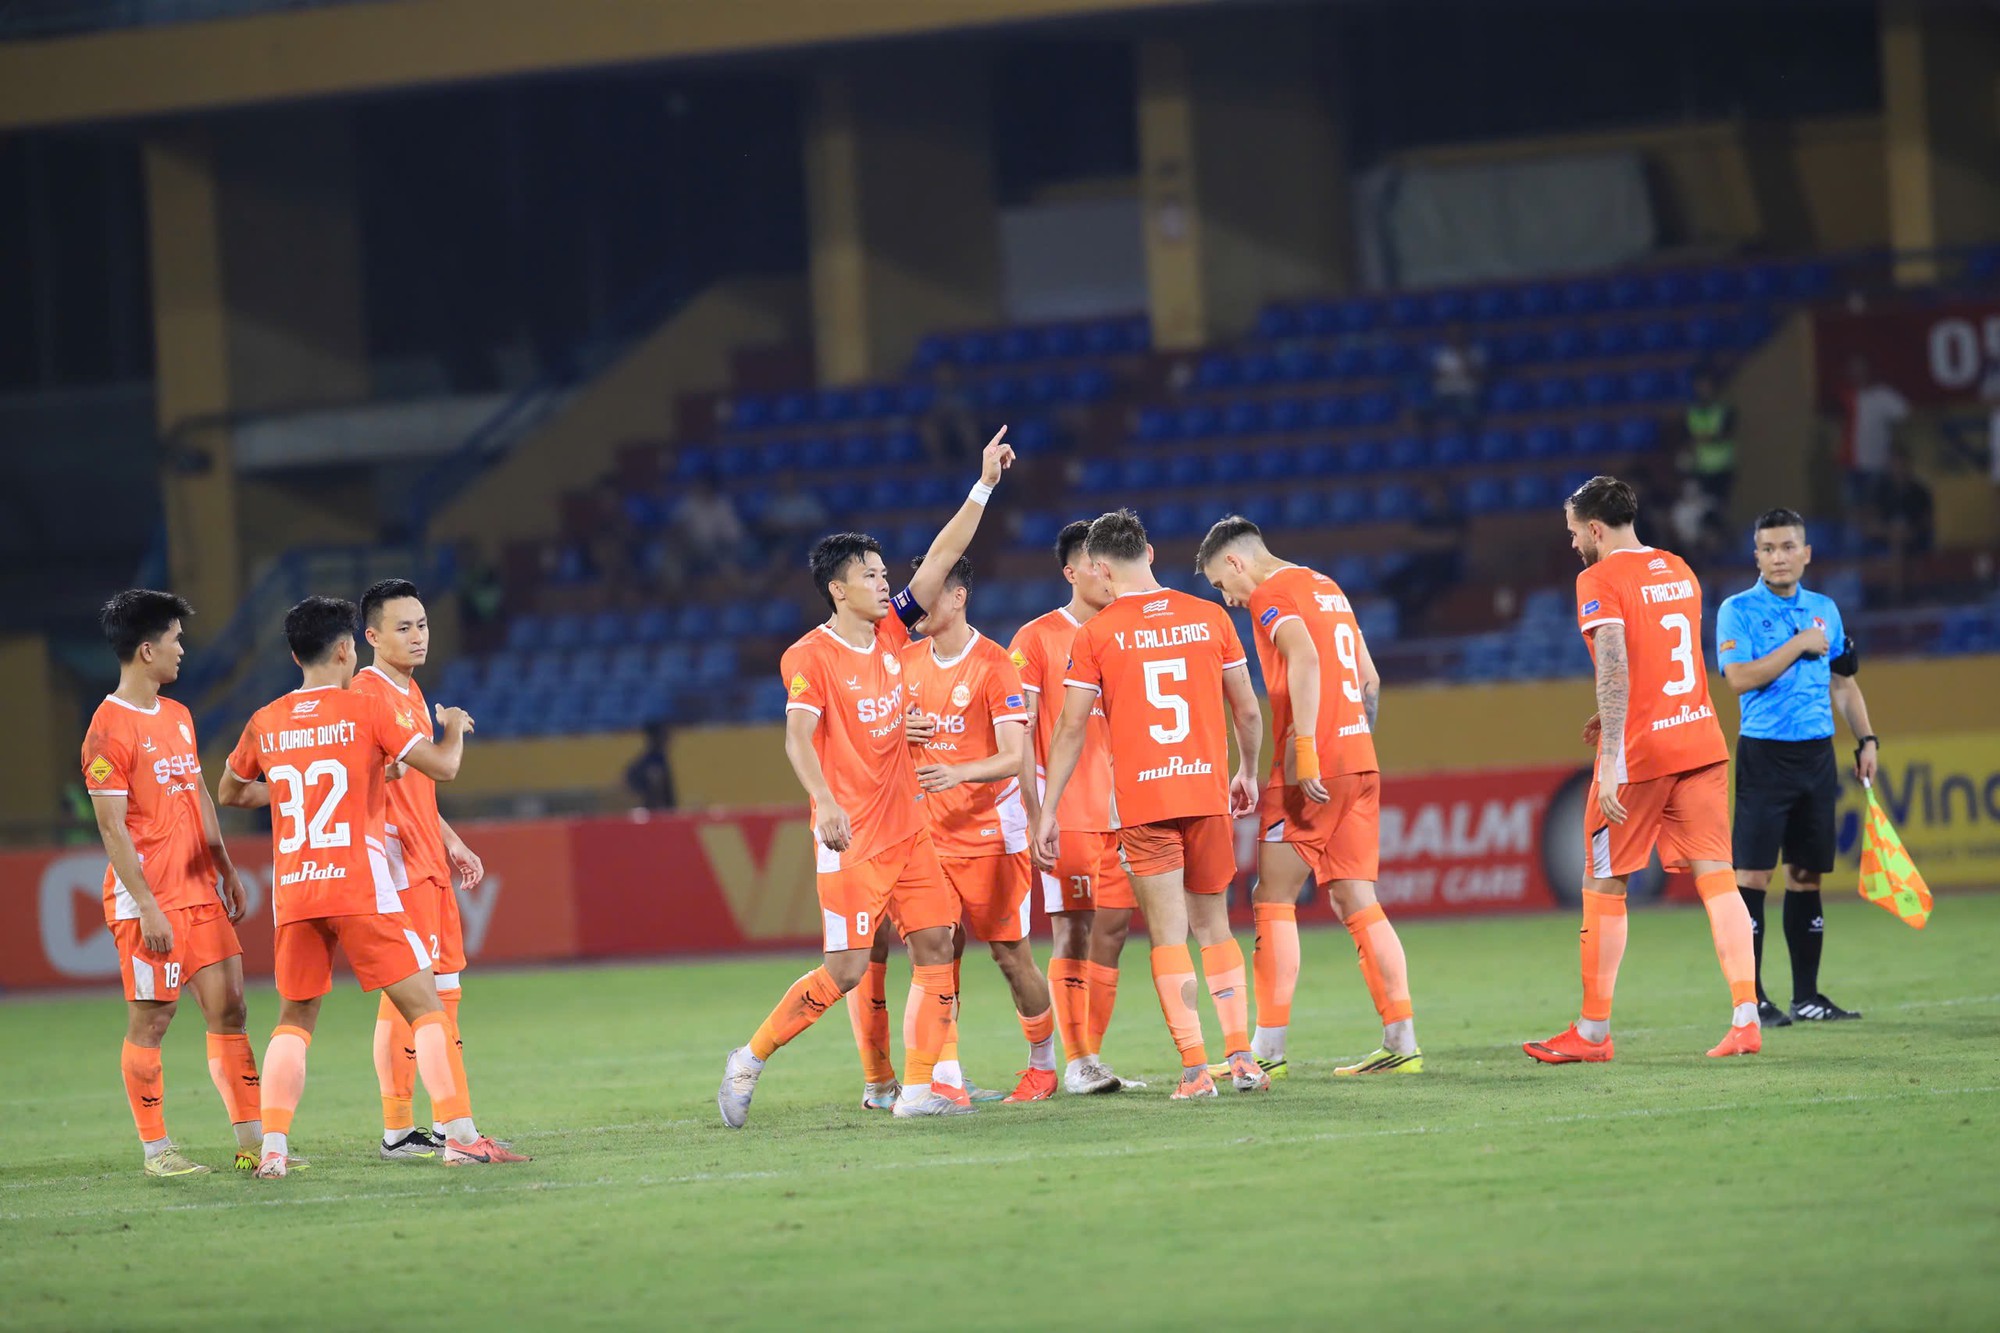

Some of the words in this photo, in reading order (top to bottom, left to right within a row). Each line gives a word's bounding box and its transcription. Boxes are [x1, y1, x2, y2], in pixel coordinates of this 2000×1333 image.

[1641, 579, 1694, 605] FRACCHIA
[1114, 632, 1133, 650] Y.
[1134, 623, 1211, 650] CALLEROS
[1334, 623, 1363, 703] 9
[1659, 613, 1696, 697] 3
[1143, 657, 1190, 744] 5
[279, 728, 315, 752] QUANG
[317, 719, 356, 747] DUYỆT
[1338, 715, 1371, 737] muR
[919, 741, 958, 751] KARA
[1137, 756, 1212, 782] muRata
[166, 783, 196, 796] TAKAR
[268, 759, 351, 854] 32
[280, 860, 347, 887] muRata
[1070, 875, 1092, 898] 37
[856, 911, 869, 936] 8
[429, 934, 440, 959] 2
[164, 962, 181, 988] 18
